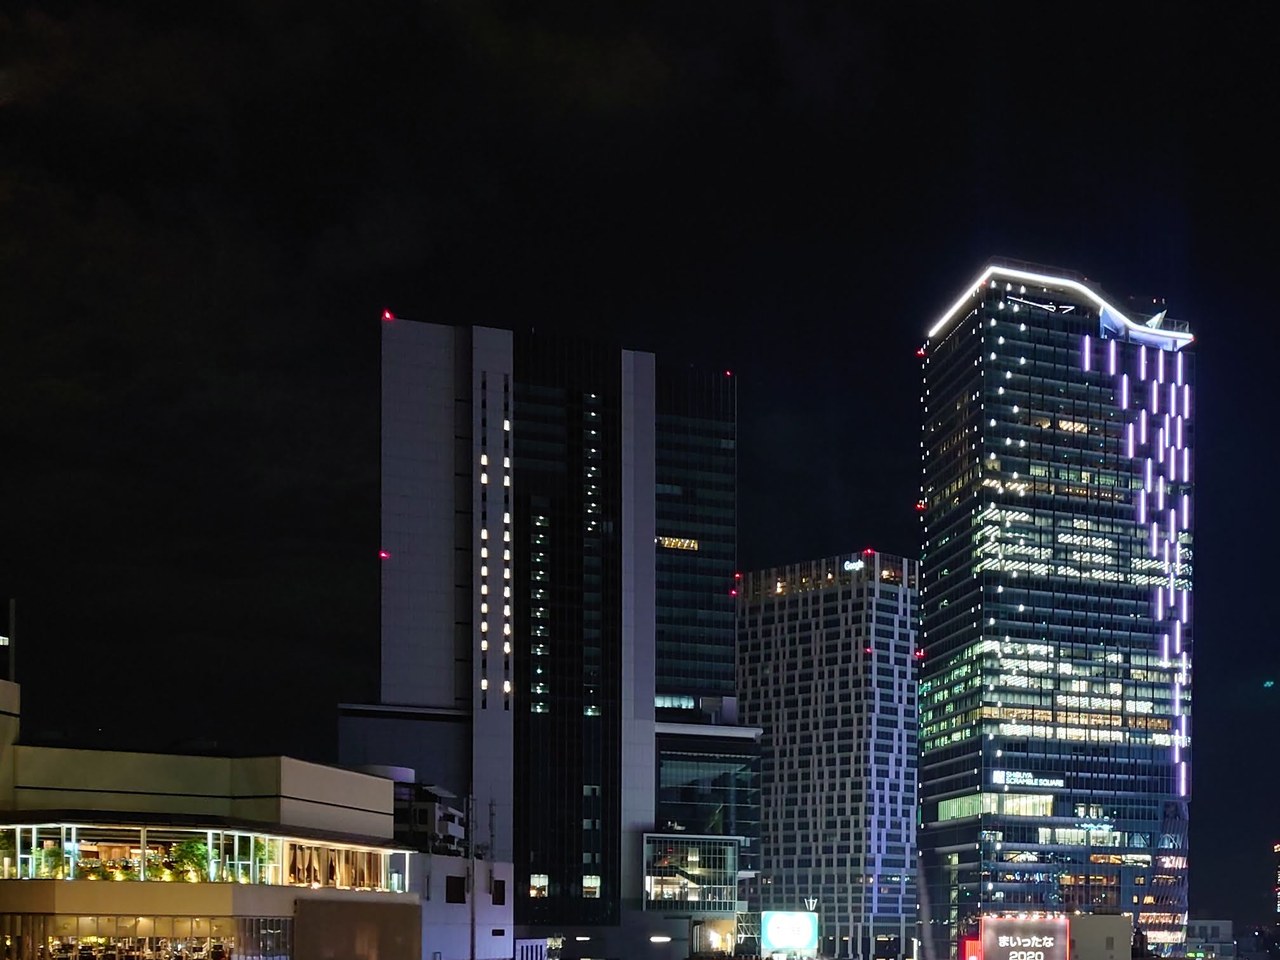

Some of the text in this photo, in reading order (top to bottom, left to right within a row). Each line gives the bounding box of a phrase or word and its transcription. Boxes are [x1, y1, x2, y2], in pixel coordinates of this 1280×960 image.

[844, 559, 864, 571] Google
[1005, 771, 1034, 779] SHIBUYA
[1005, 778, 1064, 787] SCRAMBLE SQUARE
[998, 936, 1054, 947] まいったな
